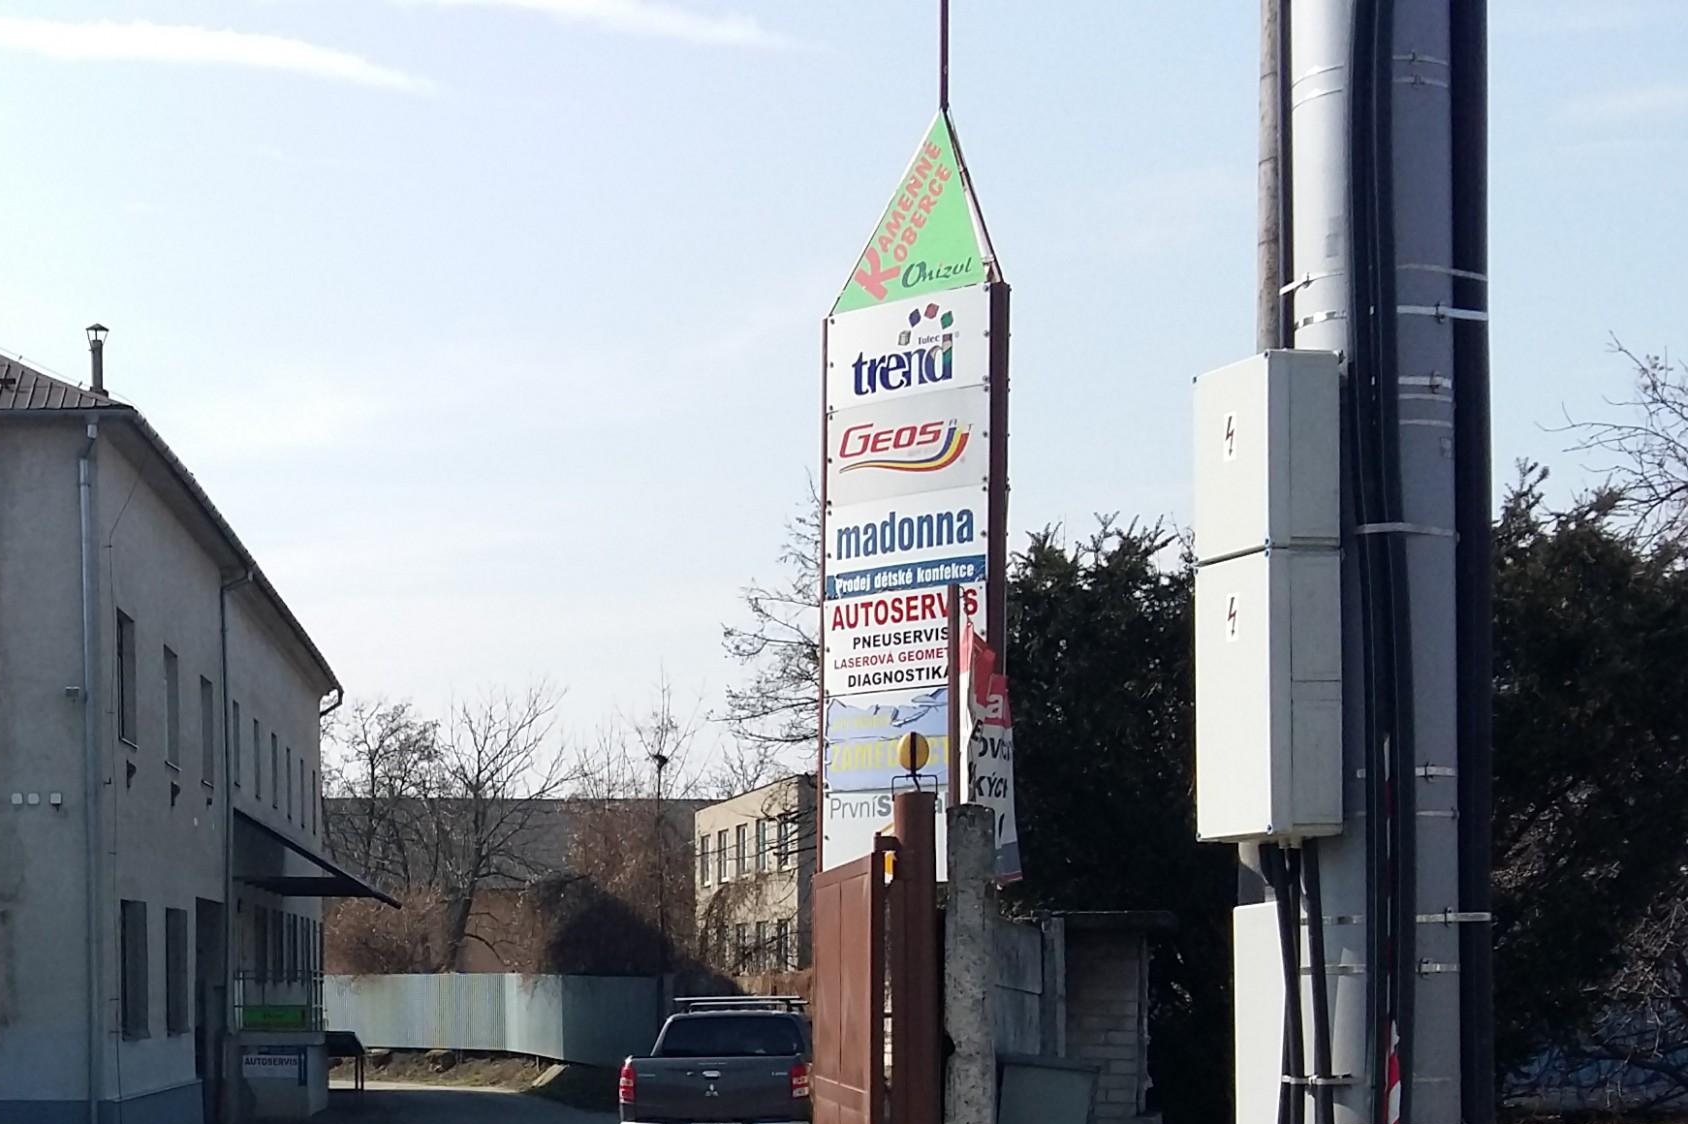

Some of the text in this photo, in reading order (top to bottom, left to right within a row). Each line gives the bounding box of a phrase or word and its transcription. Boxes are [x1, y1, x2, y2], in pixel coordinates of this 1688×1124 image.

[851, 333, 953, 396] trend
[836, 508, 974, 560] madonna
[836, 574, 870, 593] Prodej
[917, 562, 974, 582] konfekce
[832, 588, 978, 631] AUTOSERVS
